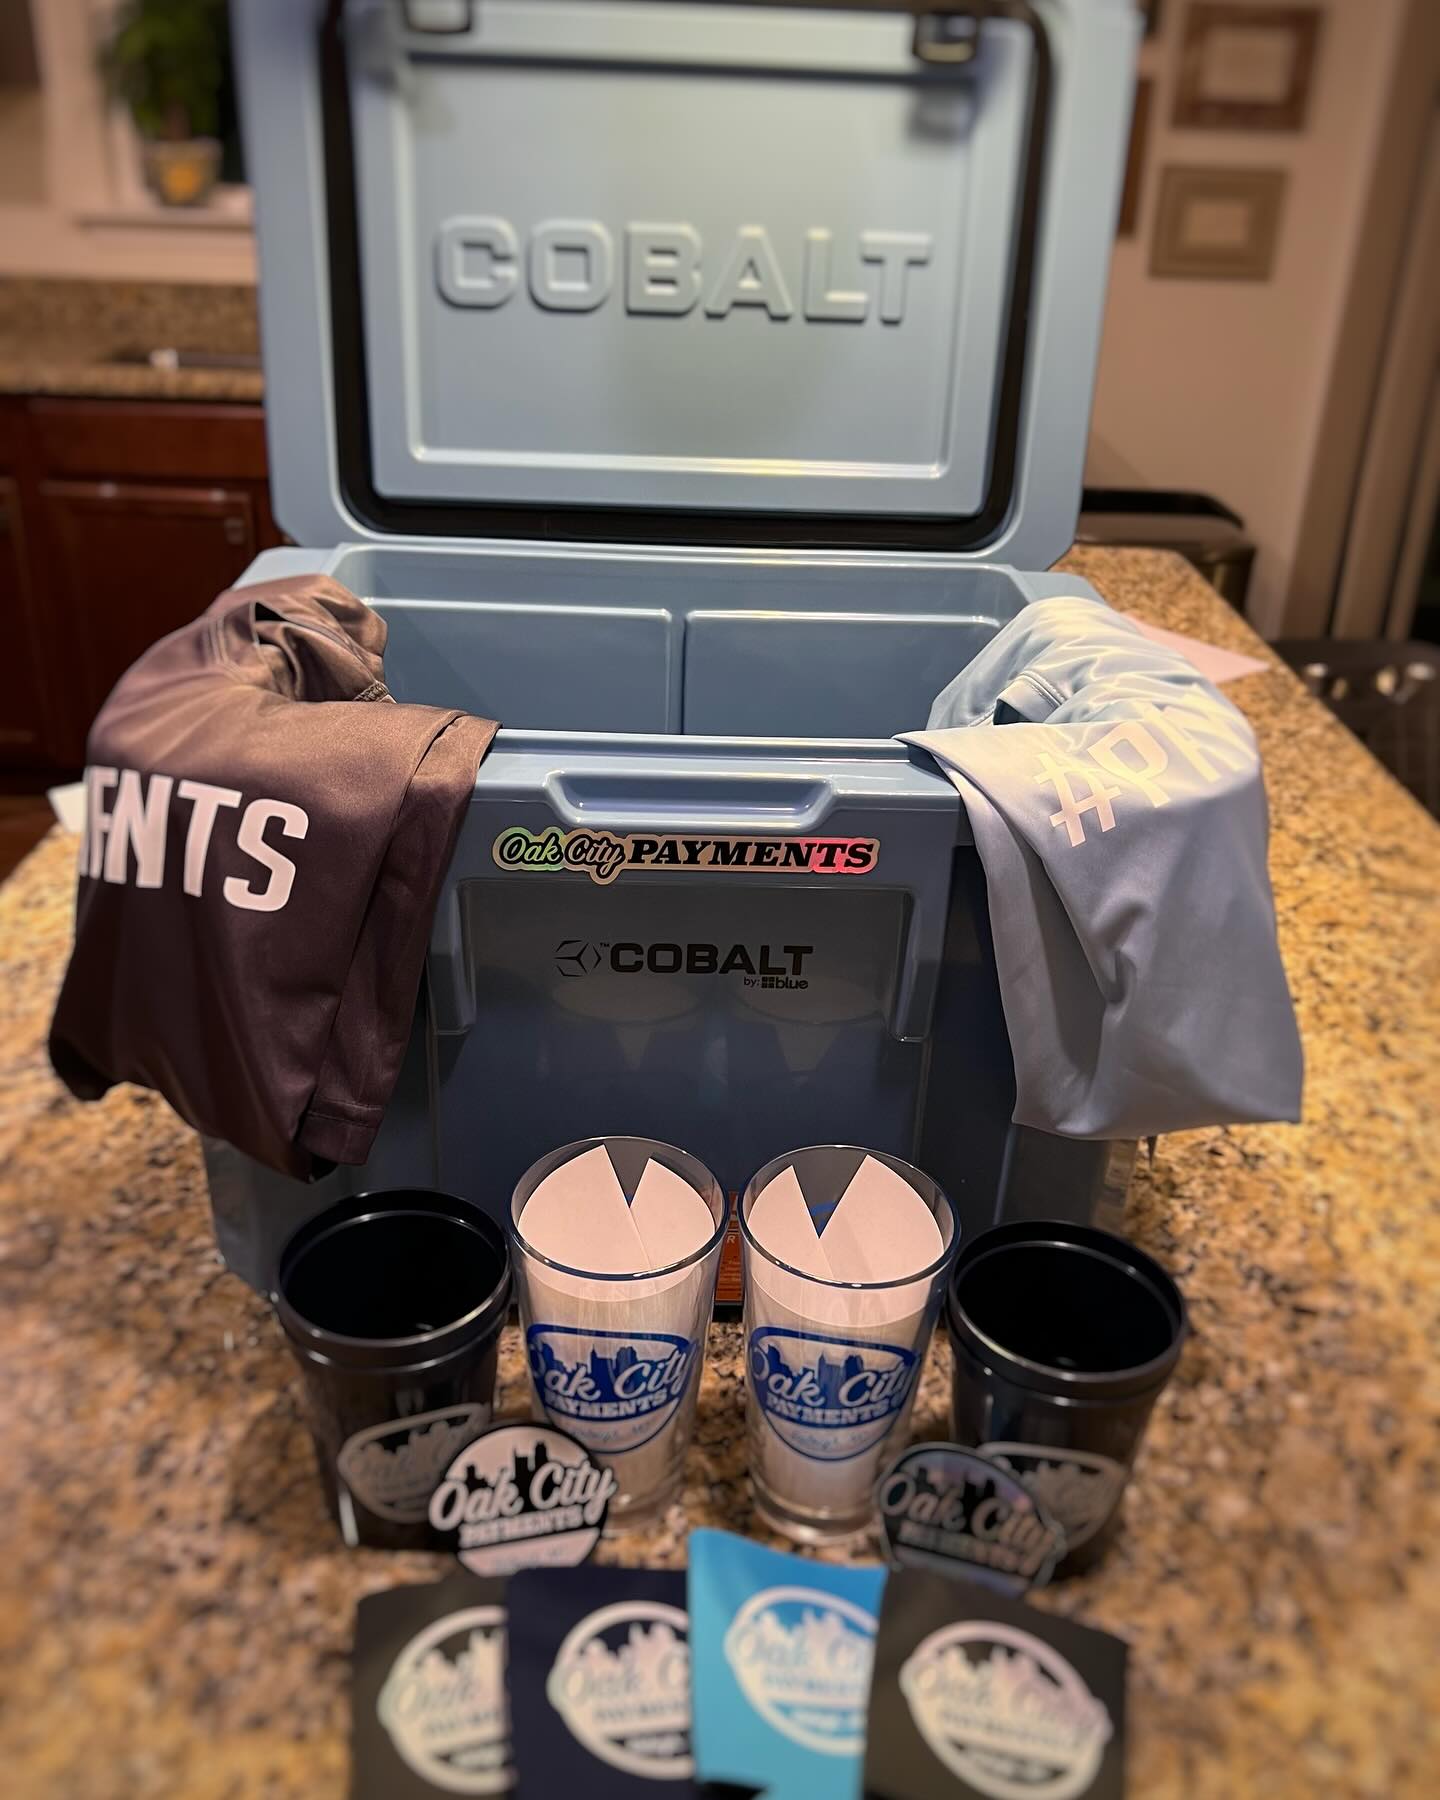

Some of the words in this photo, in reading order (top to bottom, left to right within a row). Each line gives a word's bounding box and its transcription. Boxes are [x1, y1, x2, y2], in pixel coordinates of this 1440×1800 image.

[434, 215, 932, 326] COBALT
[79, 764, 309, 912] ENTS
[500, 832, 563, 865] Oak
[564, 833, 626, 879] City
[627, 838, 874, 869] PAYMENTS
[610, 942, 814, 976] COBALT
[775, 976, 809, 989] blue
[429, 1466, 524, 1531] Oak
[529, 1460, 618, 1525] City
[880, 1473, 967, 1532] Oak
